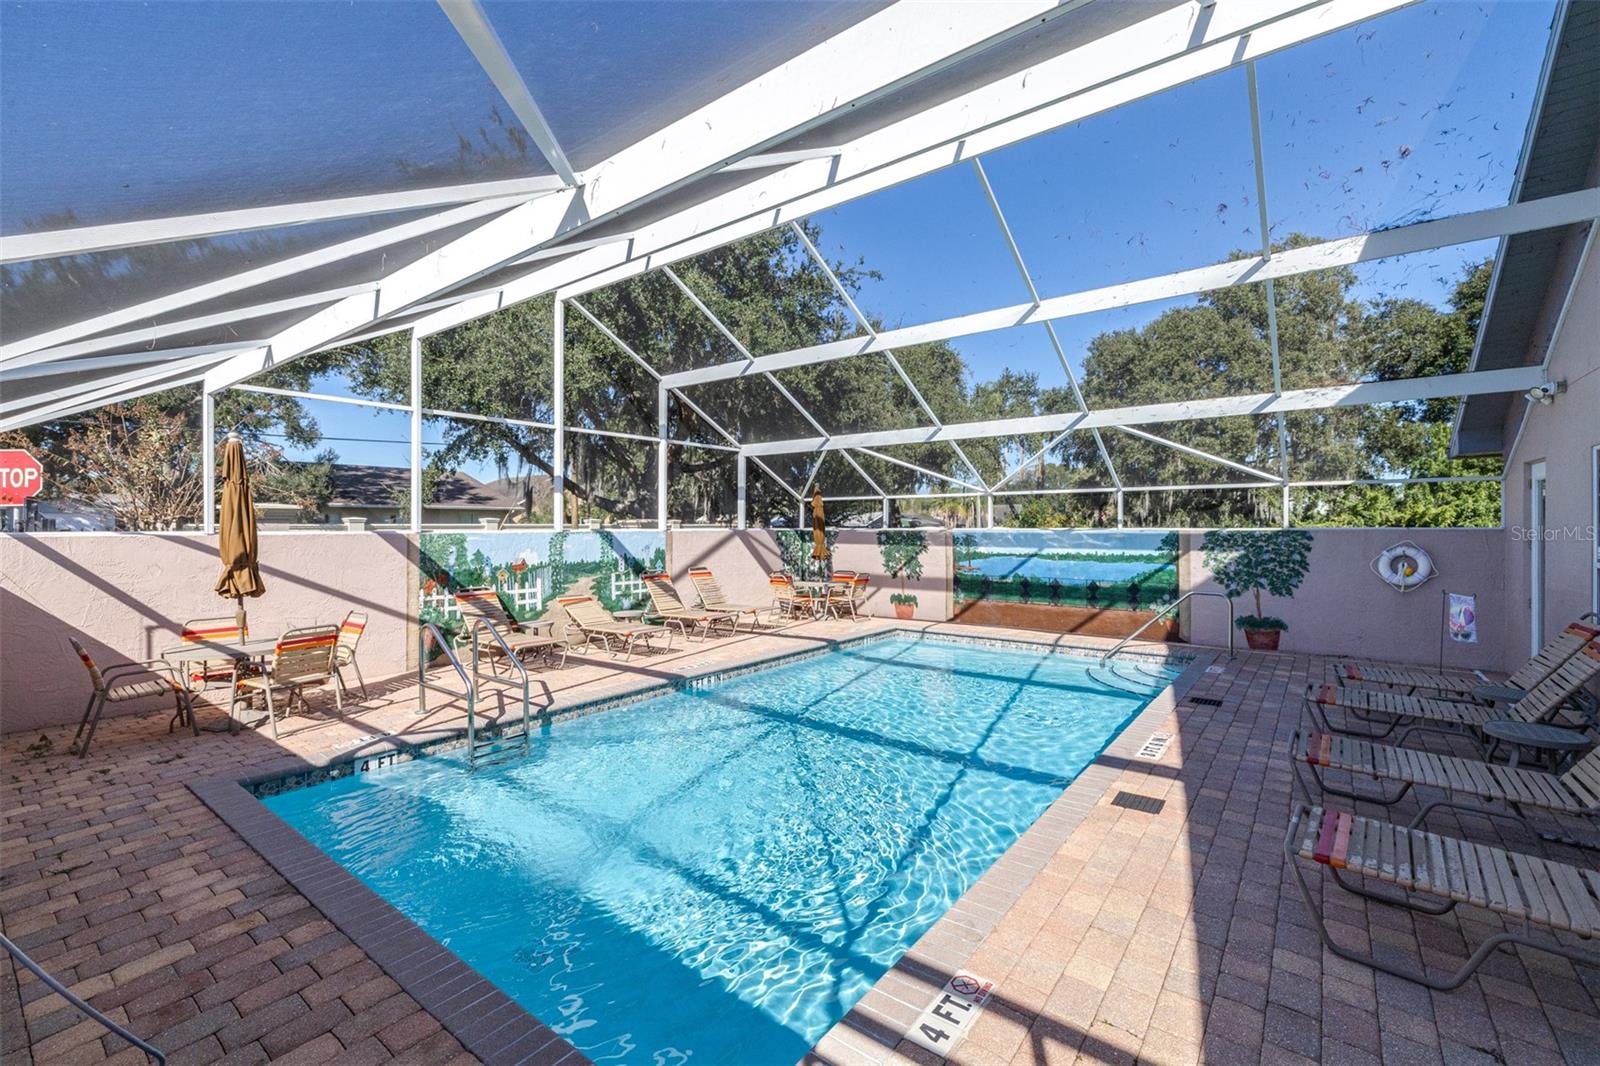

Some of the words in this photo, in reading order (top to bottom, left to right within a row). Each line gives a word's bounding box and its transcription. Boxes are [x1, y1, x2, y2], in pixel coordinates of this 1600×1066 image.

[0, 467, 38, 488] TOP
[361, 760, 370, 772] 4
[378, 753, 396, 768] FT
[919, 1023, 951, 1043] 4
